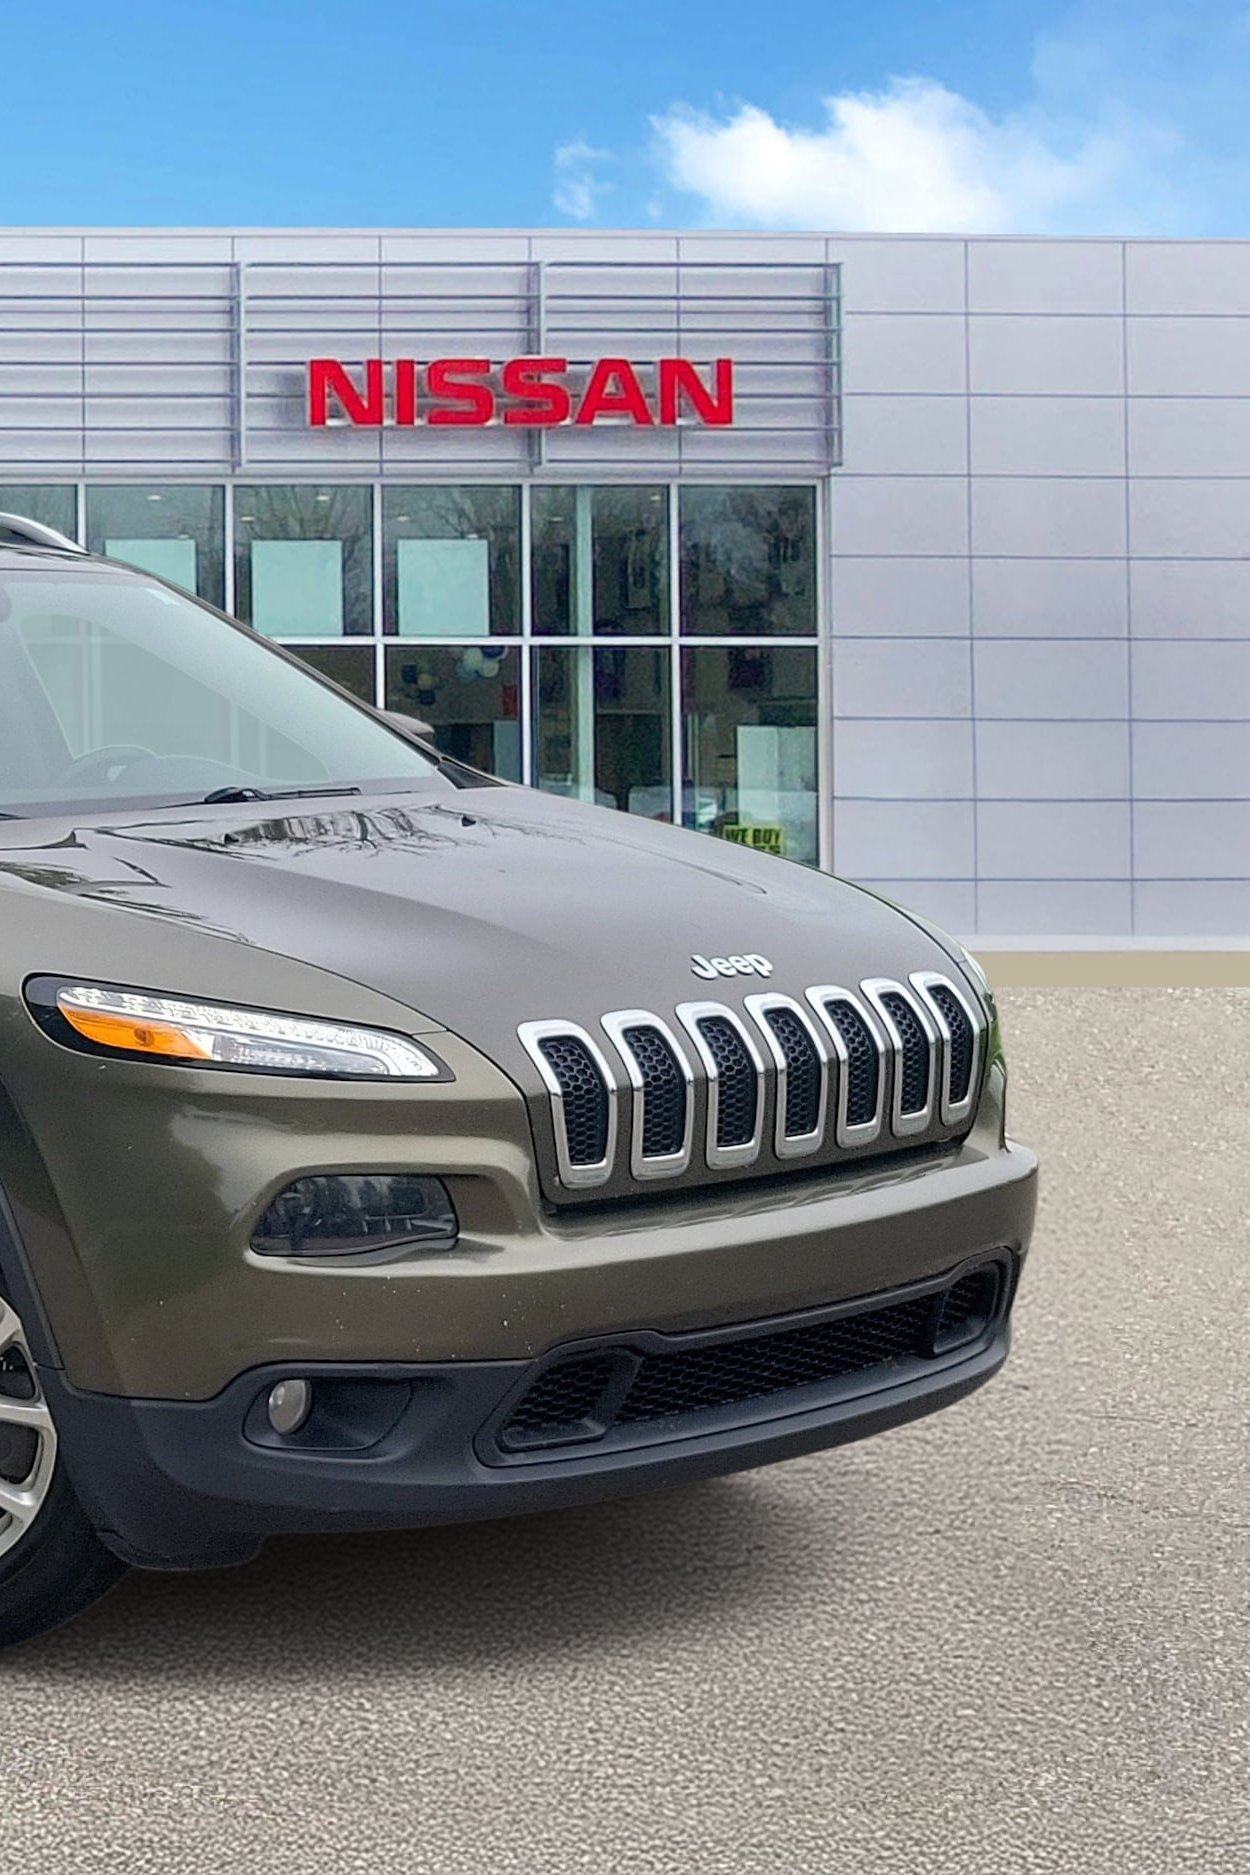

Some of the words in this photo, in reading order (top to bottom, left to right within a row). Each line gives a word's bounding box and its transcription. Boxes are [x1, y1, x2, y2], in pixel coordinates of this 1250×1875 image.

[308, 358, 734, 427] NISSAN
[725, 828, 748, 844] WE
[752, 828, 781, 845] BUY
[691, 953, 774, 980] Jeep
